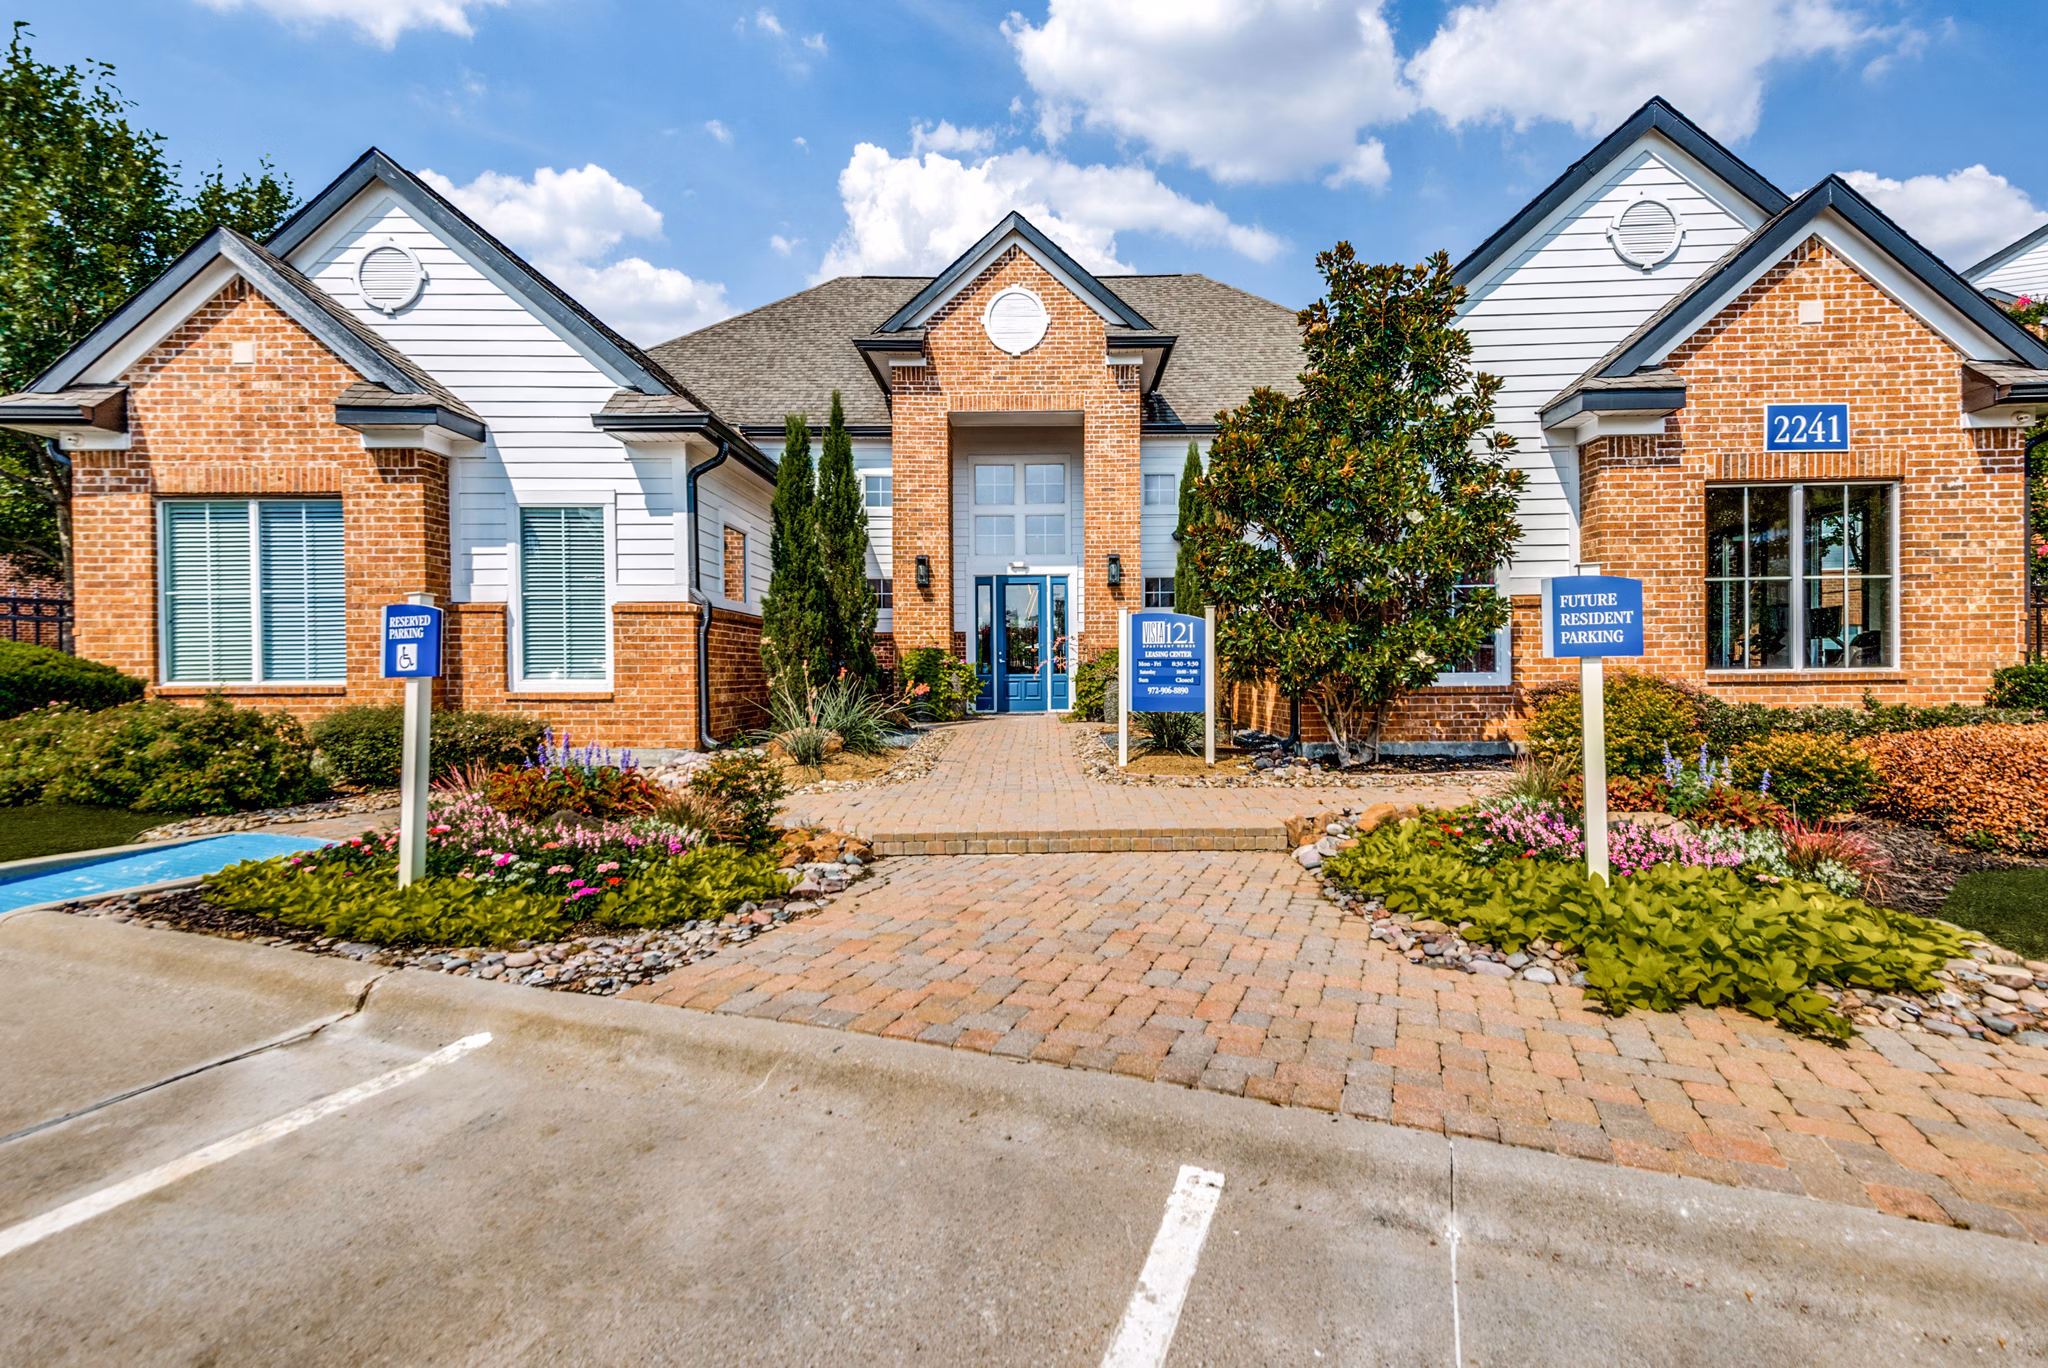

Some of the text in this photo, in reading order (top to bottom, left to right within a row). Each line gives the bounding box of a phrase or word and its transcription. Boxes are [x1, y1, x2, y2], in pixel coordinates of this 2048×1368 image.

[1774, 412, 1841, 443] 2241
[1560, 593, 1617, 608] FUTURE
[389, 615, 431, 628] RESERVED
[1560, 611, 1634, 626] RESIDENT
[388, 627, 424, 640] PARKING
[1143, 622, 1195, 644] VISTA 121
[1560, 630, 1624, 644] PARKING
